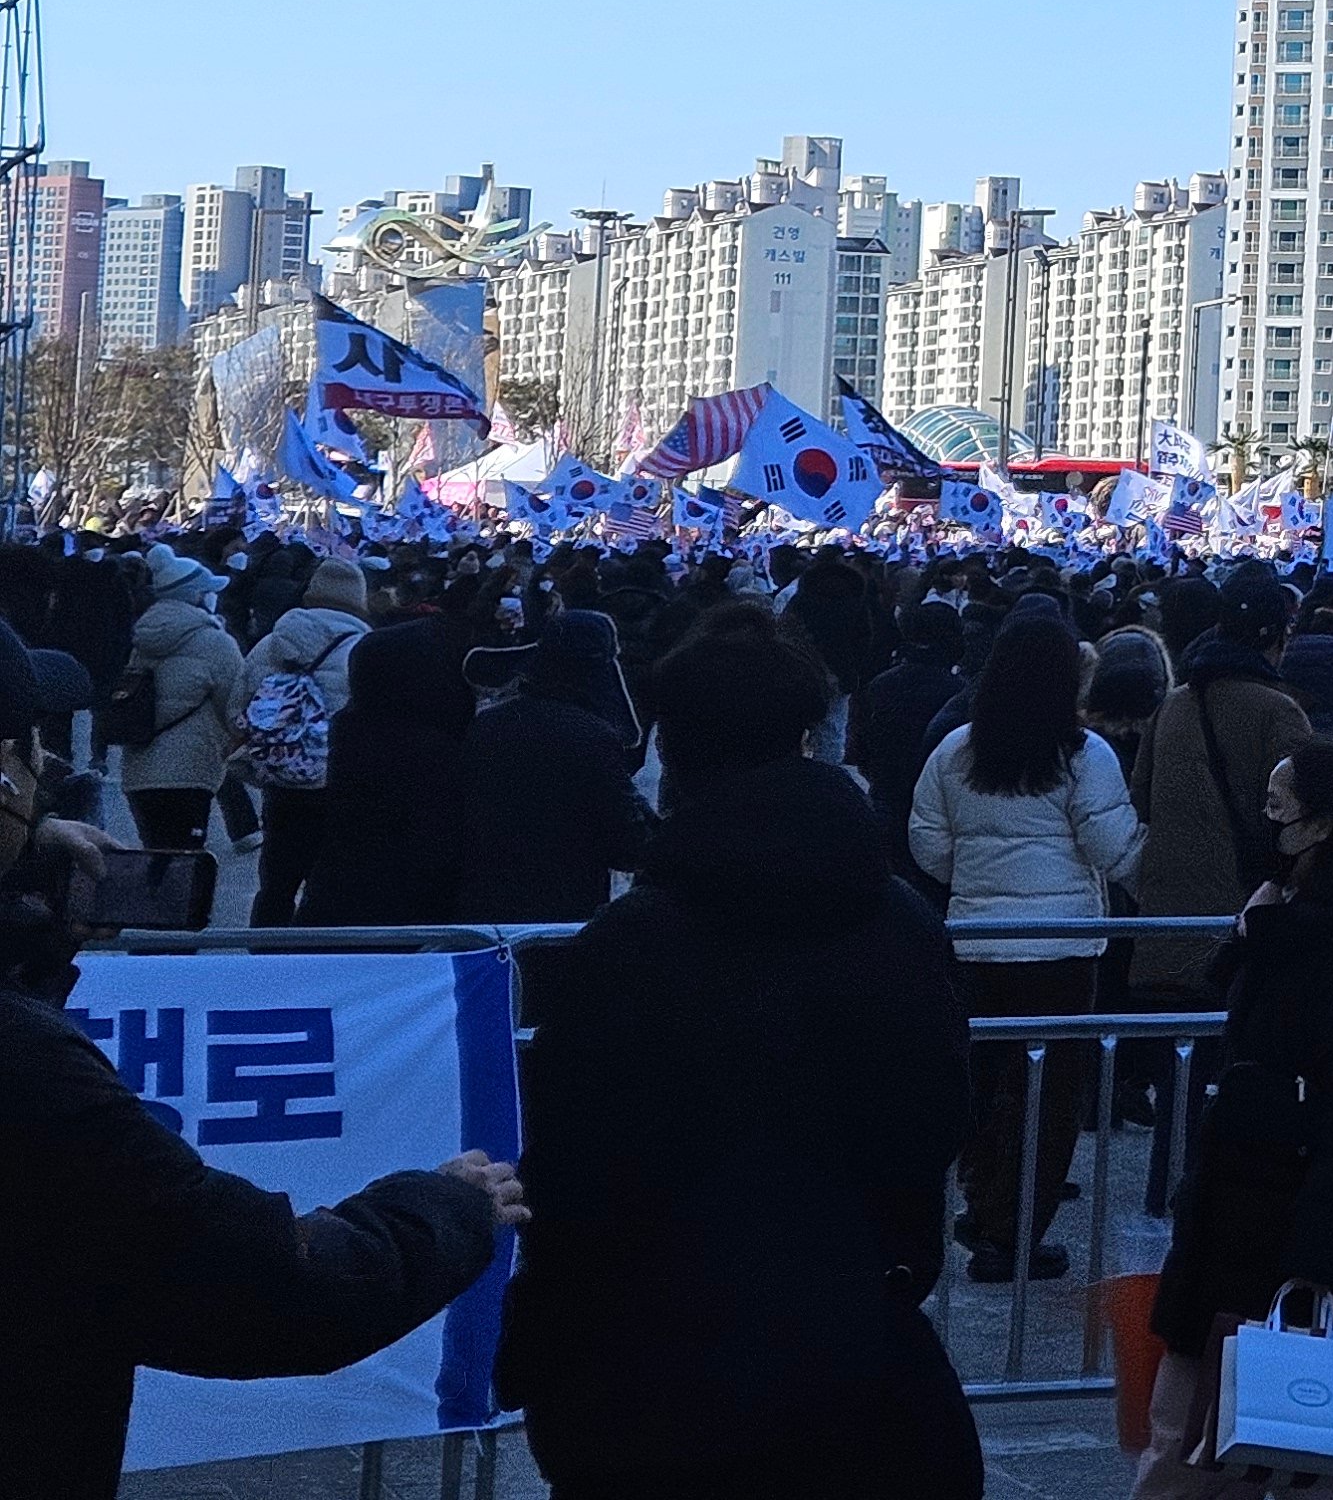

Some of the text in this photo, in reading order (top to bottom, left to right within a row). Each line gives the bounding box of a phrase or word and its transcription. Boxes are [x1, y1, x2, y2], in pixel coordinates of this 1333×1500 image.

[772, 226, 800, 241] 건영
[764, 248, 806, 264] 캐스빌
[774, 272, 792, 285] 111
